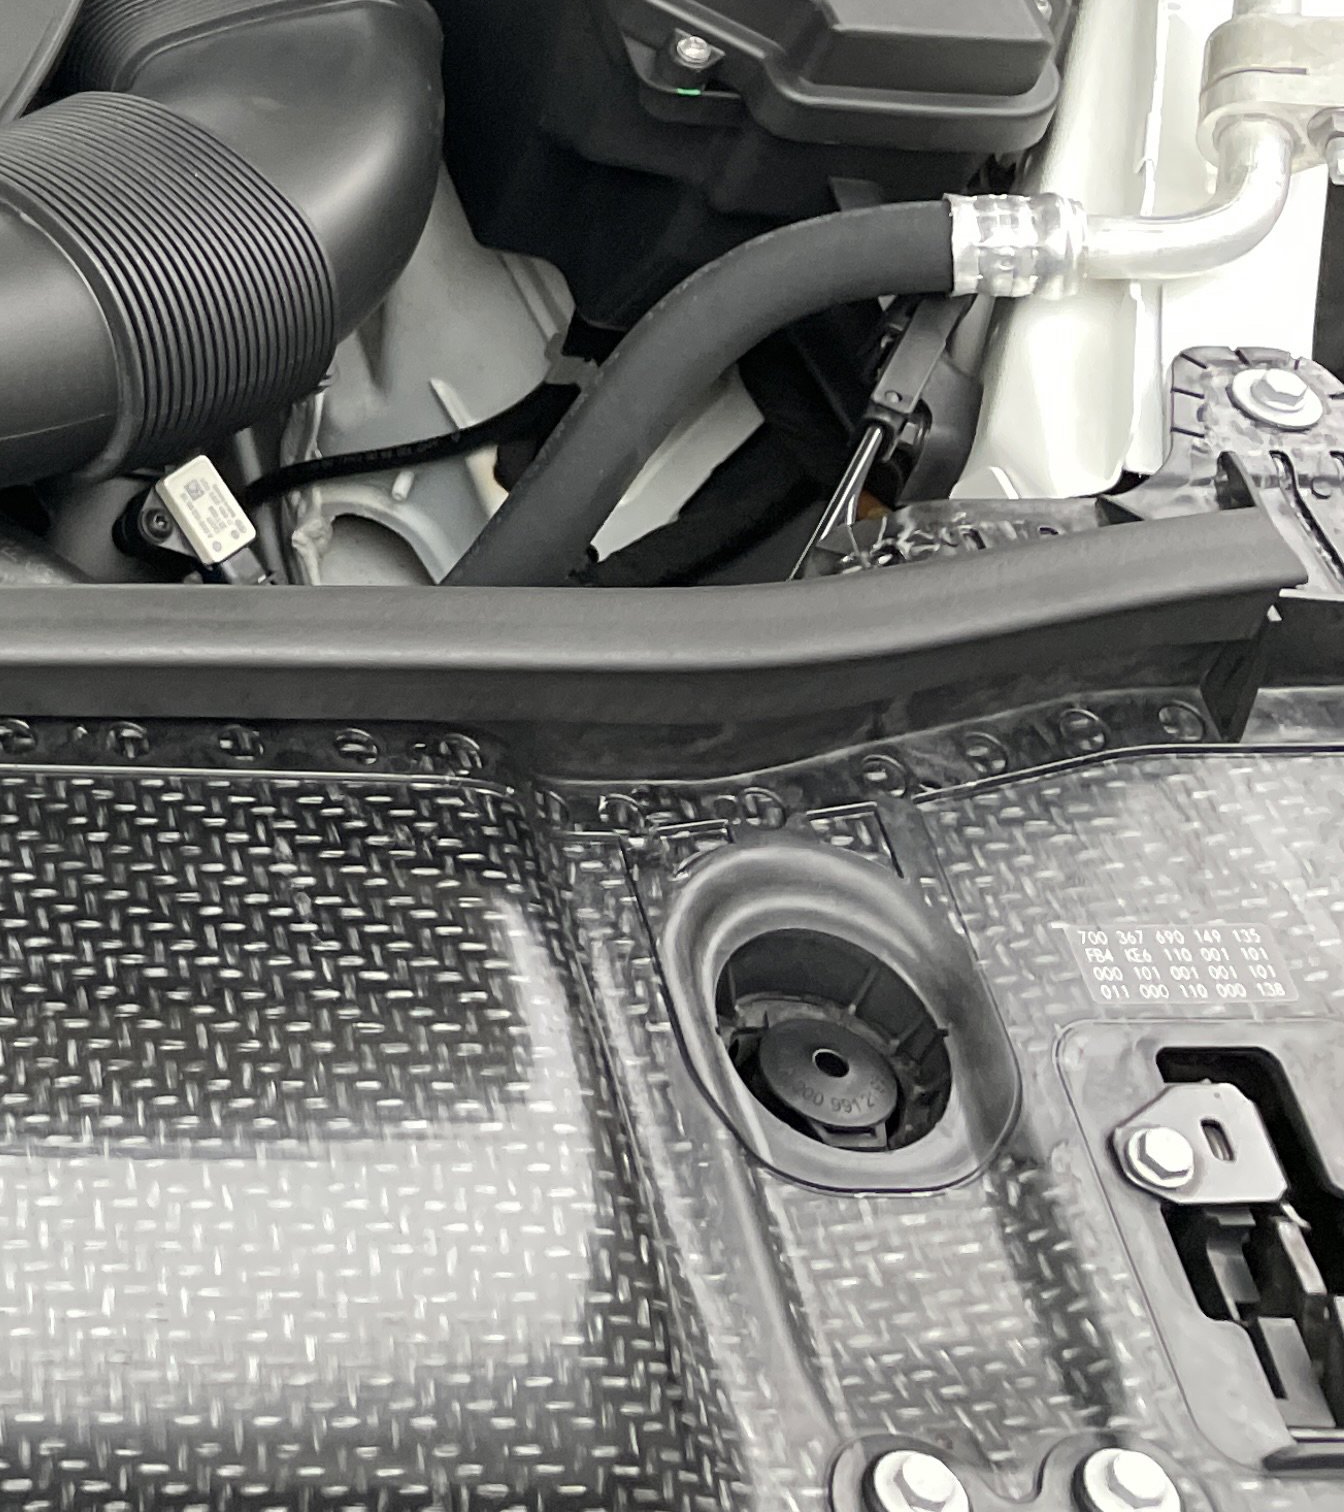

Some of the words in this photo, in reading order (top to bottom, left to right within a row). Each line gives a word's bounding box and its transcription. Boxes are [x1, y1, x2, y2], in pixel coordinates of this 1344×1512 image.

[1077, 930, 1108, 945] 700
[1116, 930, 1143, 945] 367
[1155, 930, 1185, 944] 690
[1193, 929, 1222, 943] 149
[1232, 928, 1261, 943] 135
[1124, 948, 1152, 962] KE6
[1164, 948, 1192, 962] 110
[1200, 947, 1230, 961] 001
[1240, 947, 1269, 961] 101
[1093, 967, 1124, 981] 000
[1133, 966, 1160, 980] 101
[1170, 966, 1200, 980] 001
[1208, 966, 1237, 979] 001
[1248, 965, 1276, 979] 101
[1101, 985, 1130, 999] 011
[1139, 984, 1169, 998] 000
[1180, 984, 1208, 998] 110
[1216, 983, 1246, 997] 000
